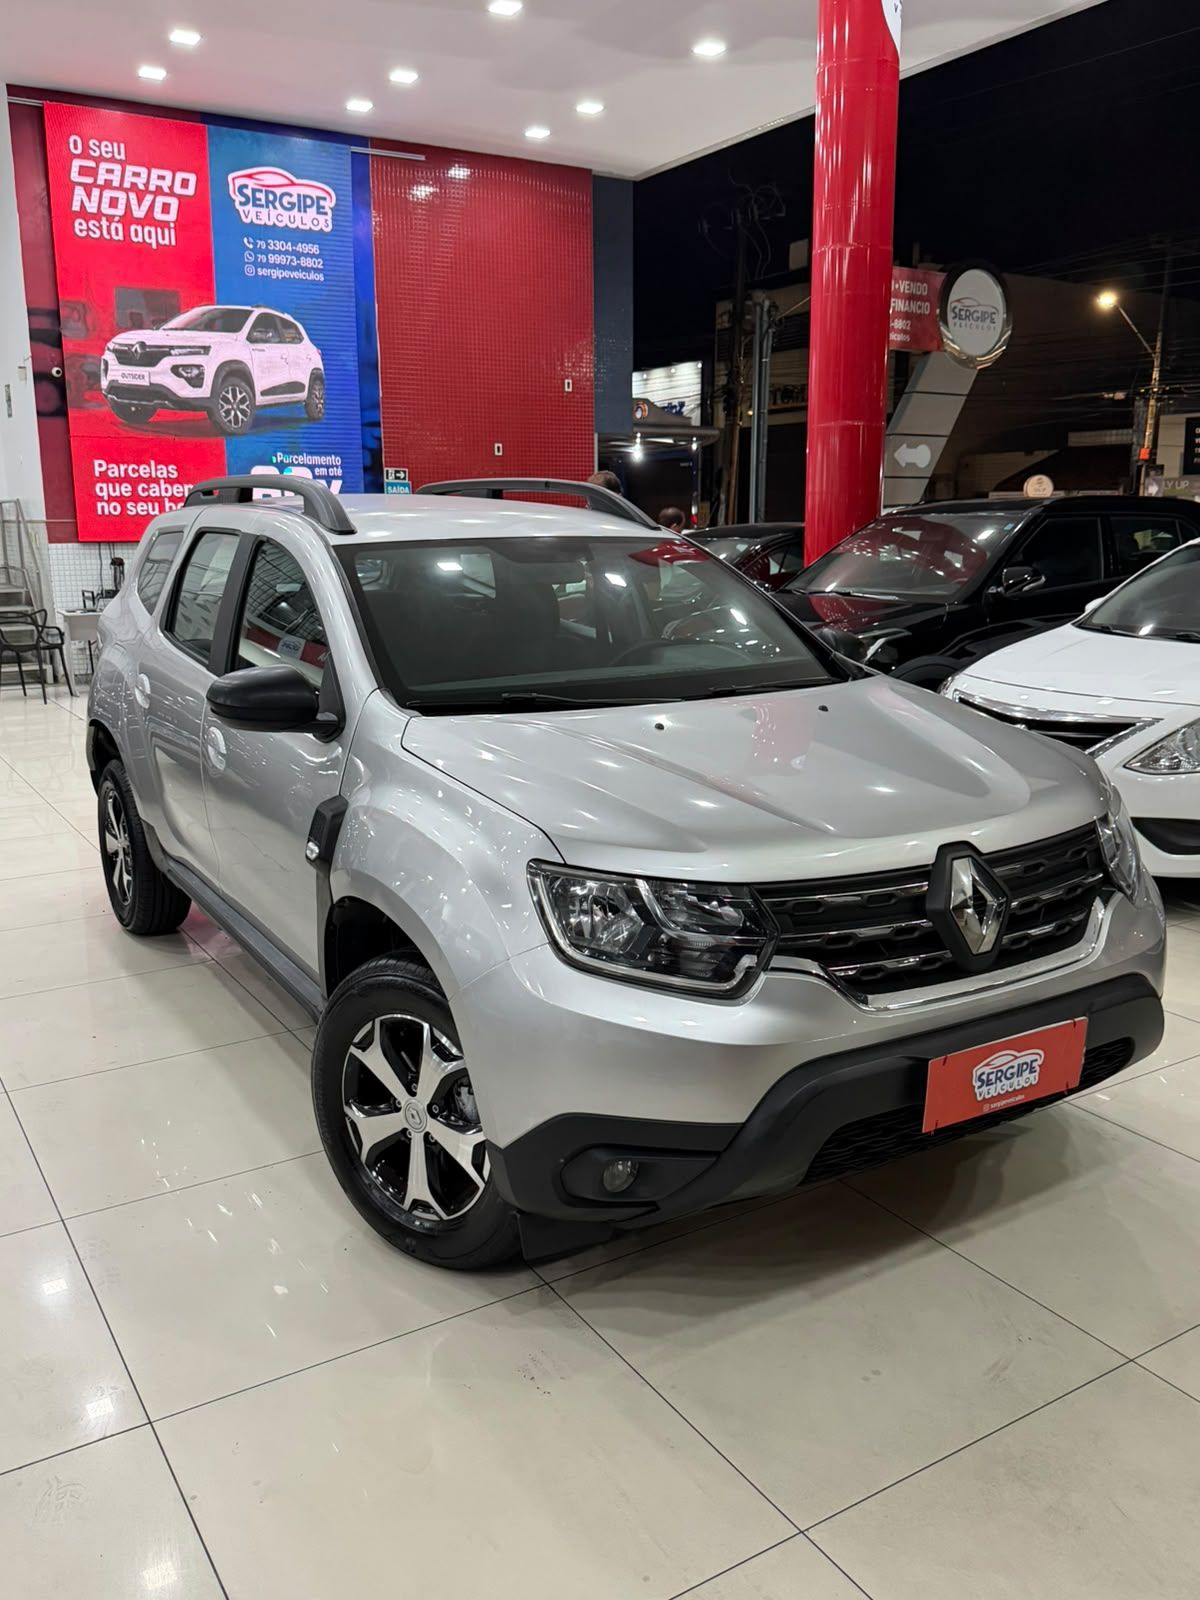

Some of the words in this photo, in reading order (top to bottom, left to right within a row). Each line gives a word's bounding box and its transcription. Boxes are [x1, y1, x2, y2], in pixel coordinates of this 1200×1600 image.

[88, 140, 126, 160] seu
[70, 158, 197, 196] CARRO
[71, 185, 179, 222] NOVO
[237, 184, 328, 215] SERGIPE
[242, 208, 330, 228] VEÍCULOS
[74, 216, 124, 241] está
[130, 223, 176, 249] aqui
[267, 239, 320, 255] 3304-4956
[268, 253, 324, 269] 99973-8802
[257, 267, 325, 281] sergipeveiculos
[899, 280, 928, 296] VENDO
[951, 305, 997, 324] SERGIPE
[276, 451, 342, 466] Parcelamento
[93, 459, 179, 479] Parcelas
[314, 466, 328, 476] em
[95, 482, 133, 500] que
[97, 501, 122, 516] no
[126, 501, 160, 516] seu
[976, 1058, 1039, 1089] SERGIPE
